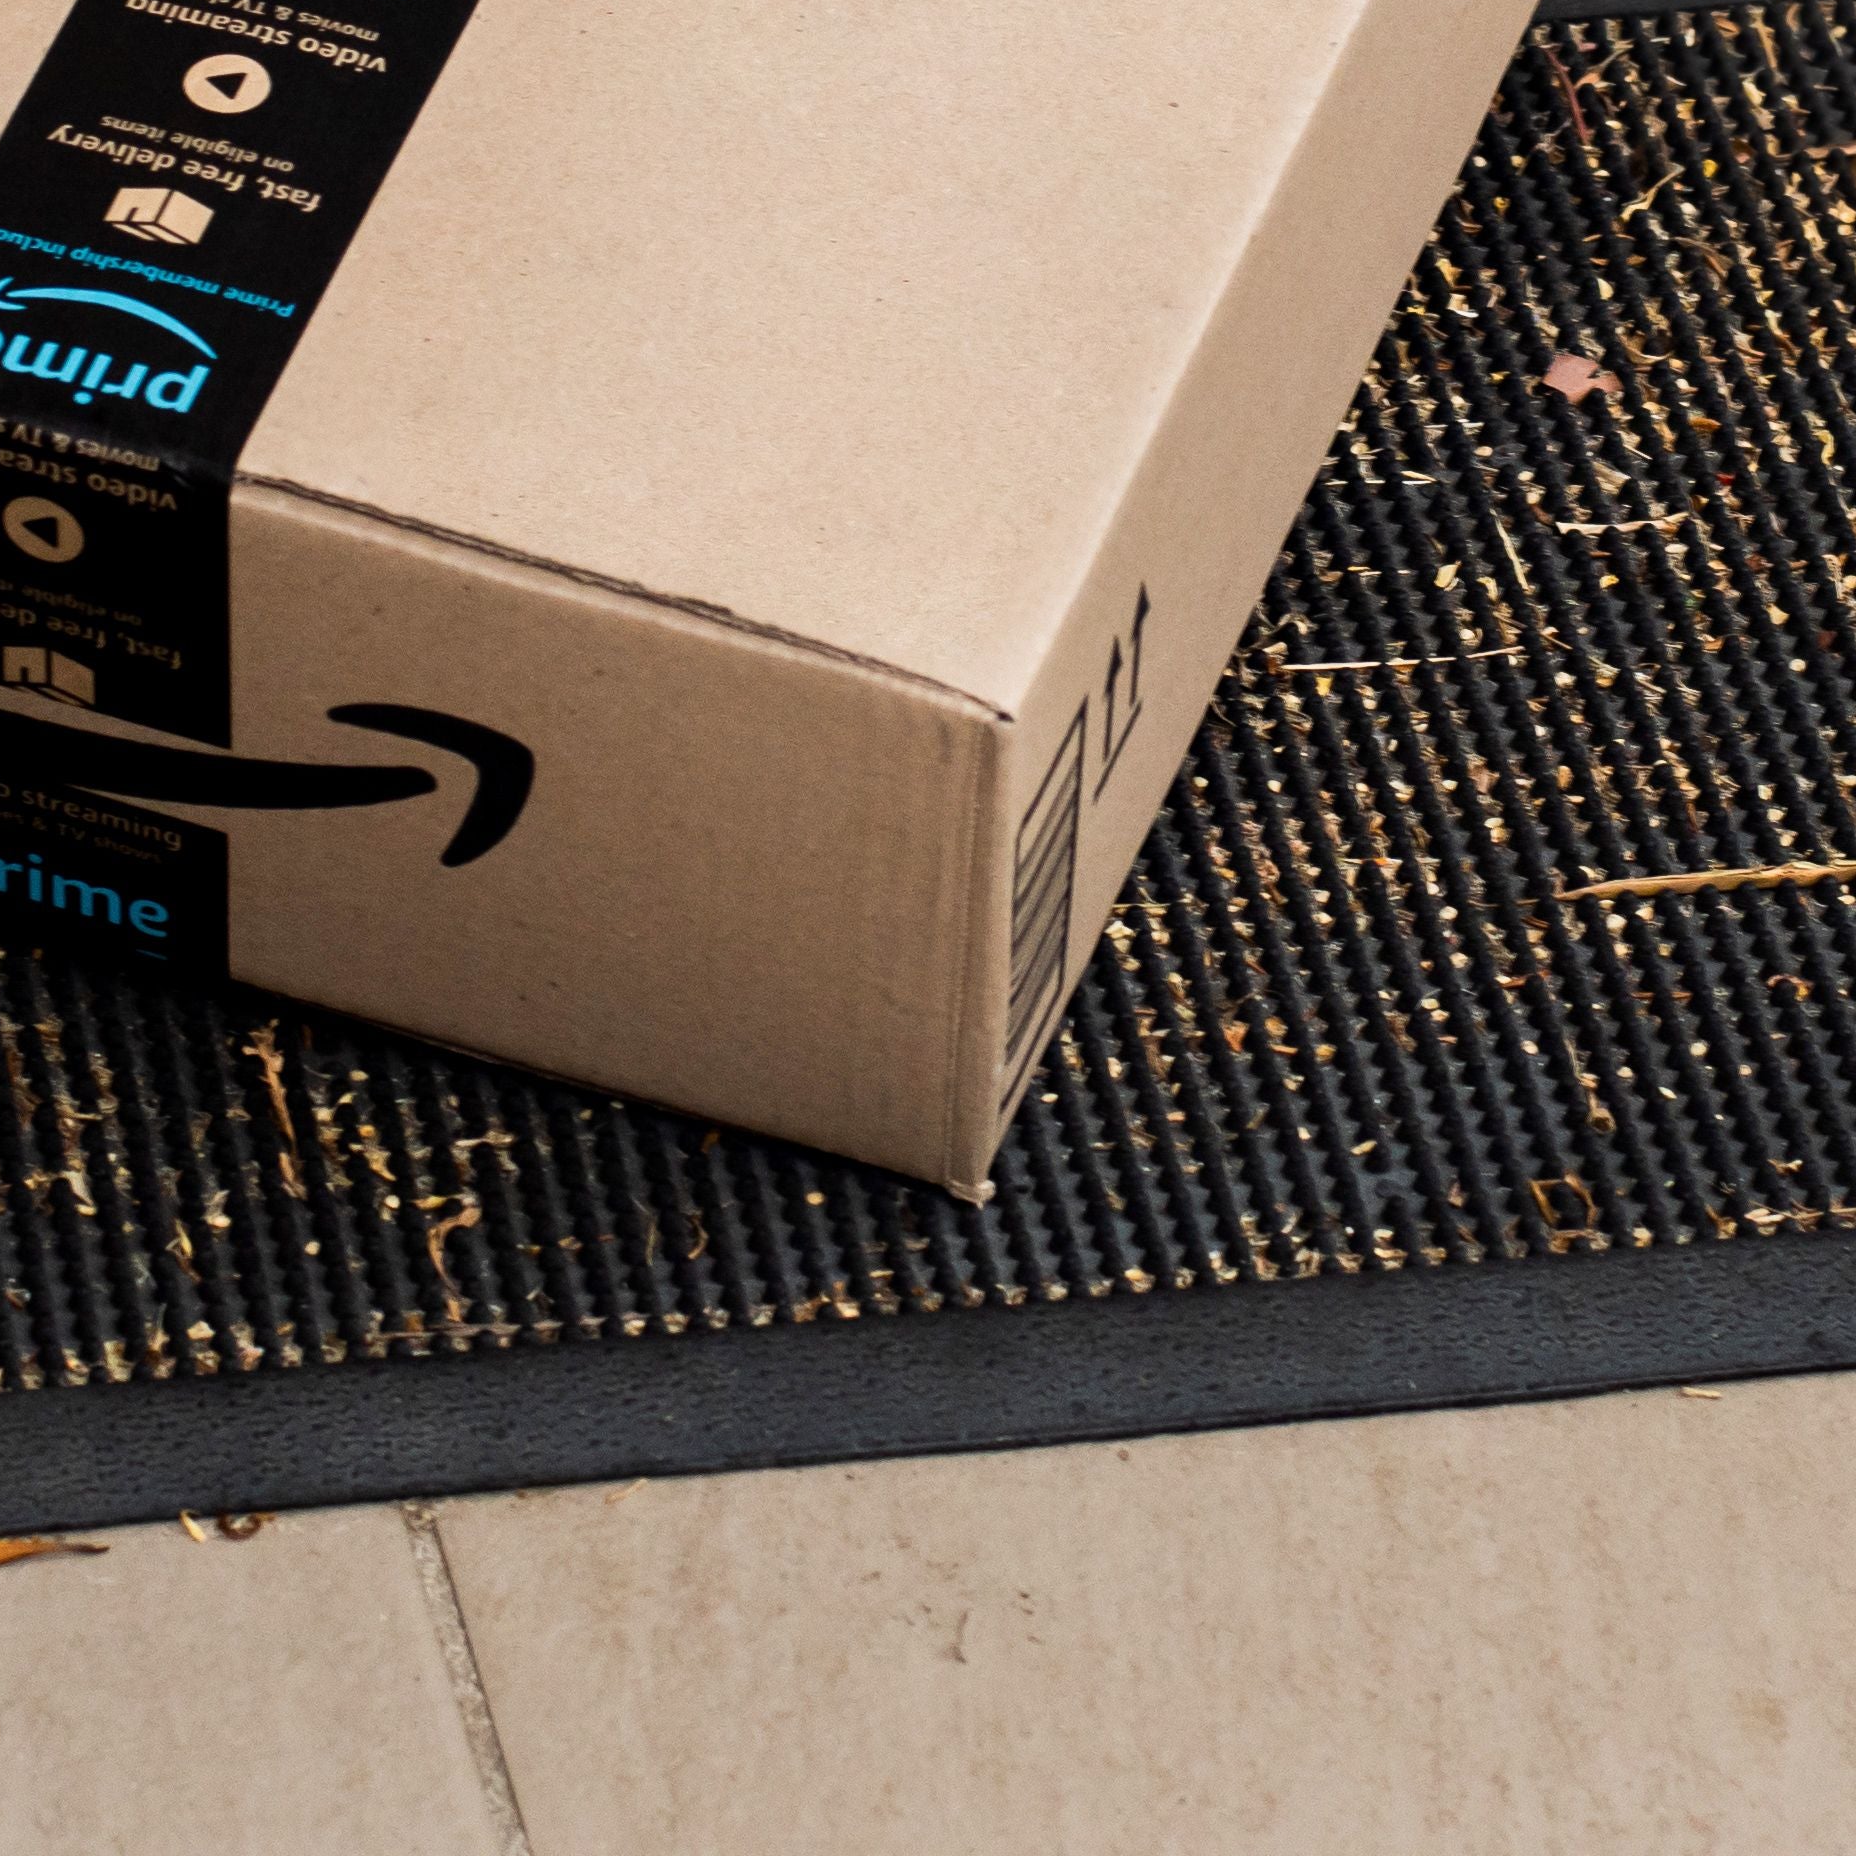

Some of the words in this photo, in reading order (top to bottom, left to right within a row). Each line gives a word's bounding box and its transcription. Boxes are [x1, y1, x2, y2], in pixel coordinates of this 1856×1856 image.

[275, 6, 293, 20] &
[297, 12, 380, 41] movies
[297, 37, 386, 72] video
[101, 116, 166, 142] items
[47, 124, 176, 171] delivery
[170, 133, 258, 163] eligible
[181, 160, 246, 192] free
[262, 157, 295, 172] on
[256, 176, 321, 212] fast,
[70, 247, 221, 294] membership
[223, 287, 296, 317] Prime
[11, 423, 43, 447] TV
[52, 432, 73, 453] &
[76, 438, 160, 472] movies
[87, 473, 176, 510] video
[47, 617, 106, 648] free
[118, 633, 181, 669] fast,
[21, 789, 183, 852] streaming
